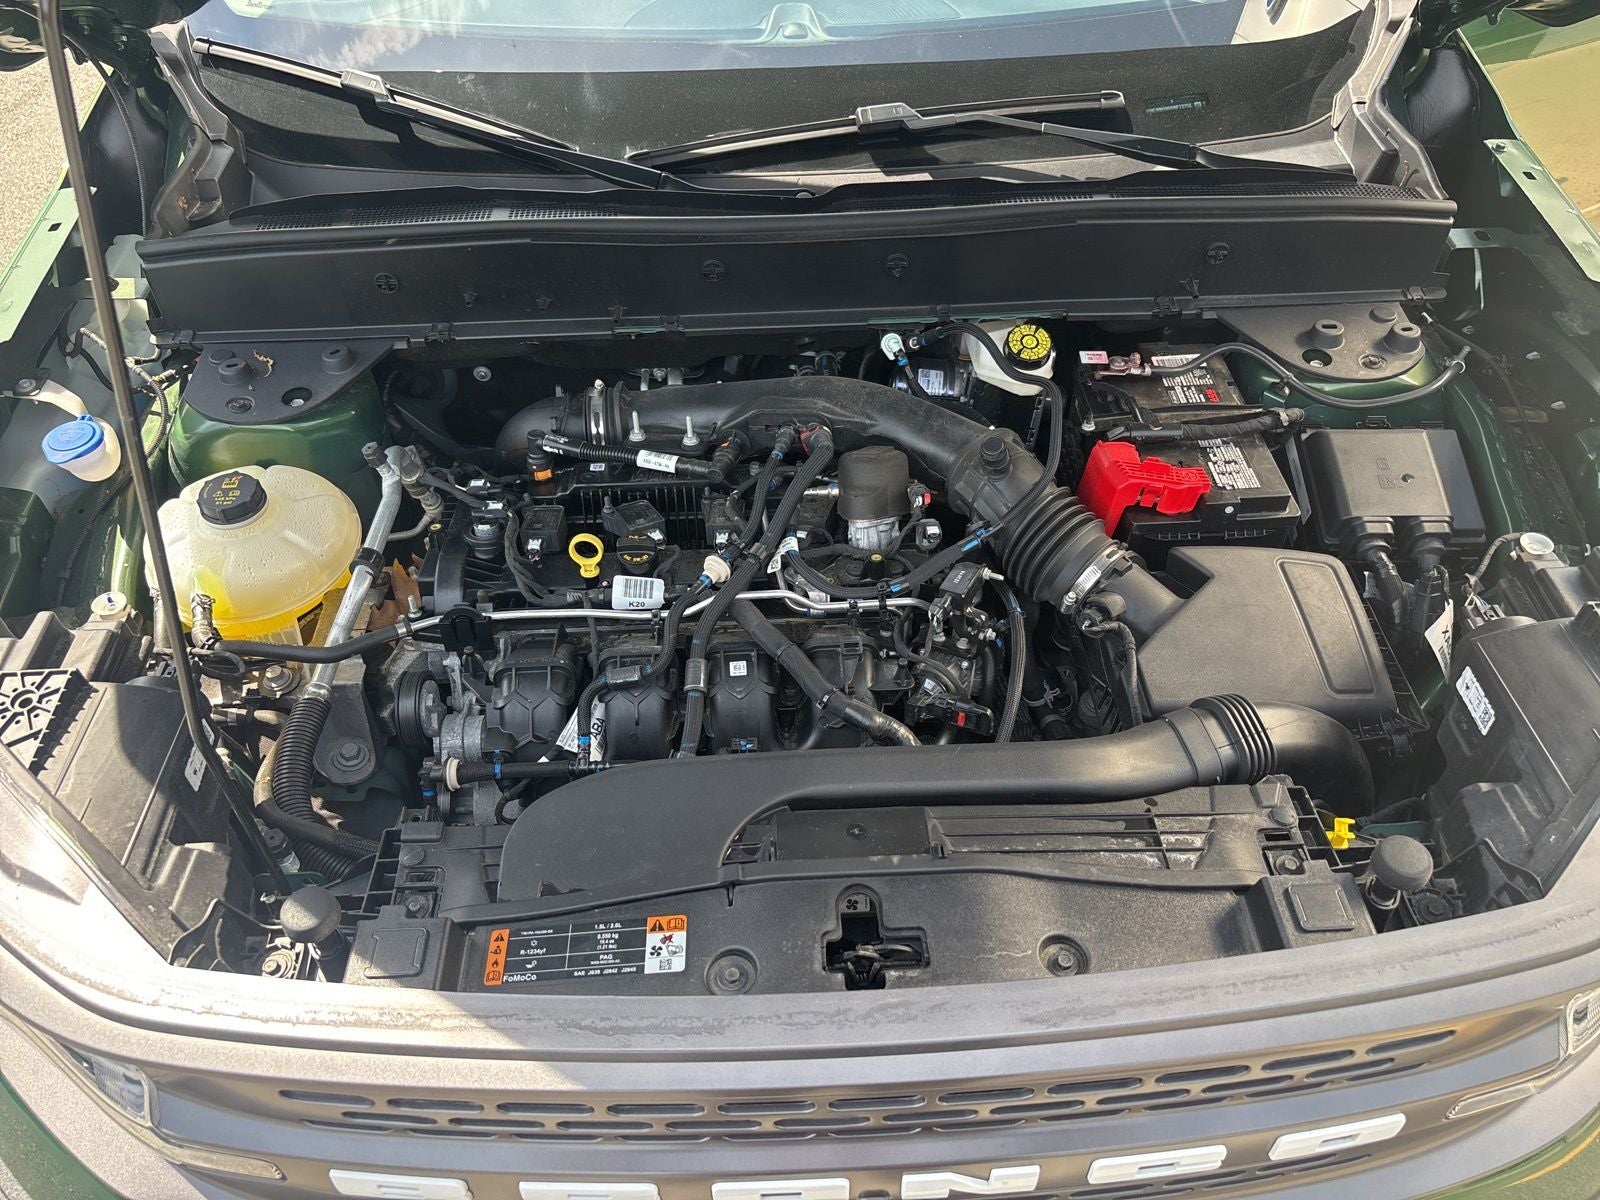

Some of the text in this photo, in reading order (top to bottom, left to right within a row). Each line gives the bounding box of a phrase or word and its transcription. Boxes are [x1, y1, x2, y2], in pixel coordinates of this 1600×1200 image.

[590, 718, 606, 740] ABA
[520, 947, 547, 956] R-1234yf
[503, 974, 536, 982] FoMoCo
